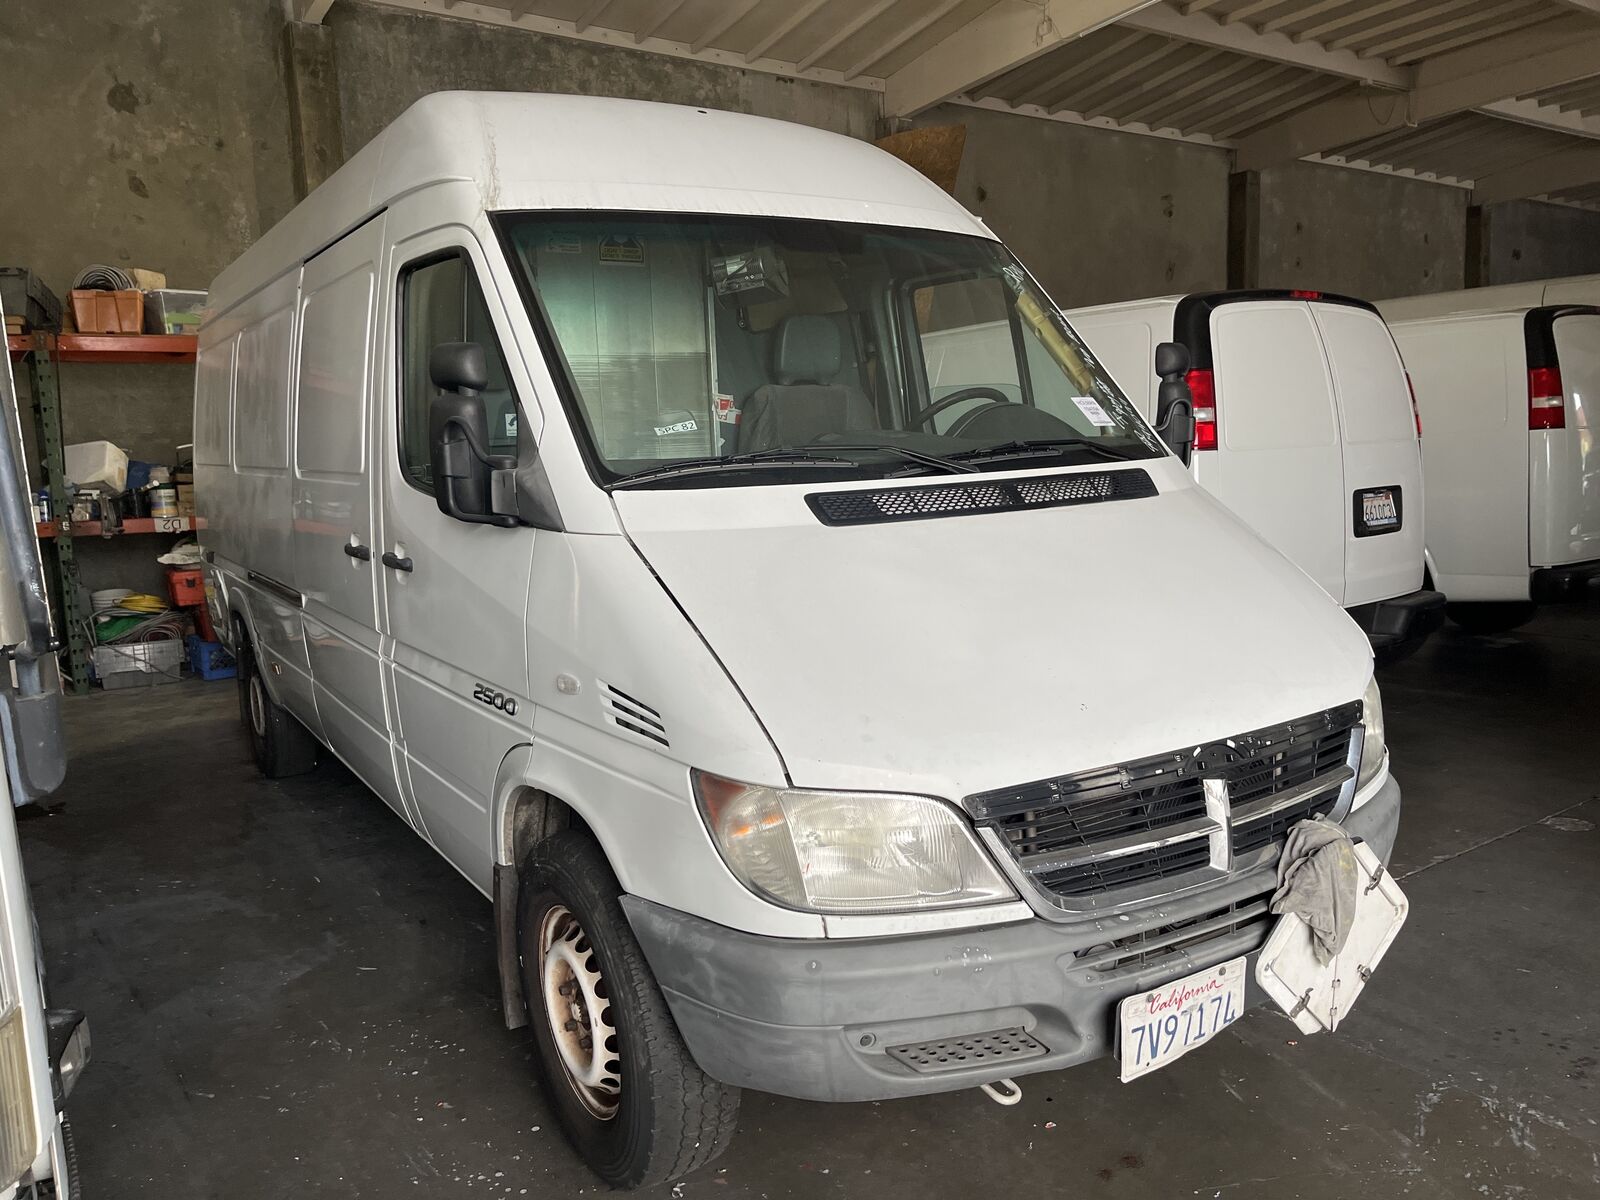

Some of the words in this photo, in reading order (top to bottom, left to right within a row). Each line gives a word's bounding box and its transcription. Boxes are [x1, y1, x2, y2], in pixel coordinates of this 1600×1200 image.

[681, 421, 695, 431] 82
[162, 519, 182, 530] D2
[473, 682, 518, 716] 2500
[1150, 975, 1224, 1015] California
[1131, 991, 1236, 1066] 7V97174
